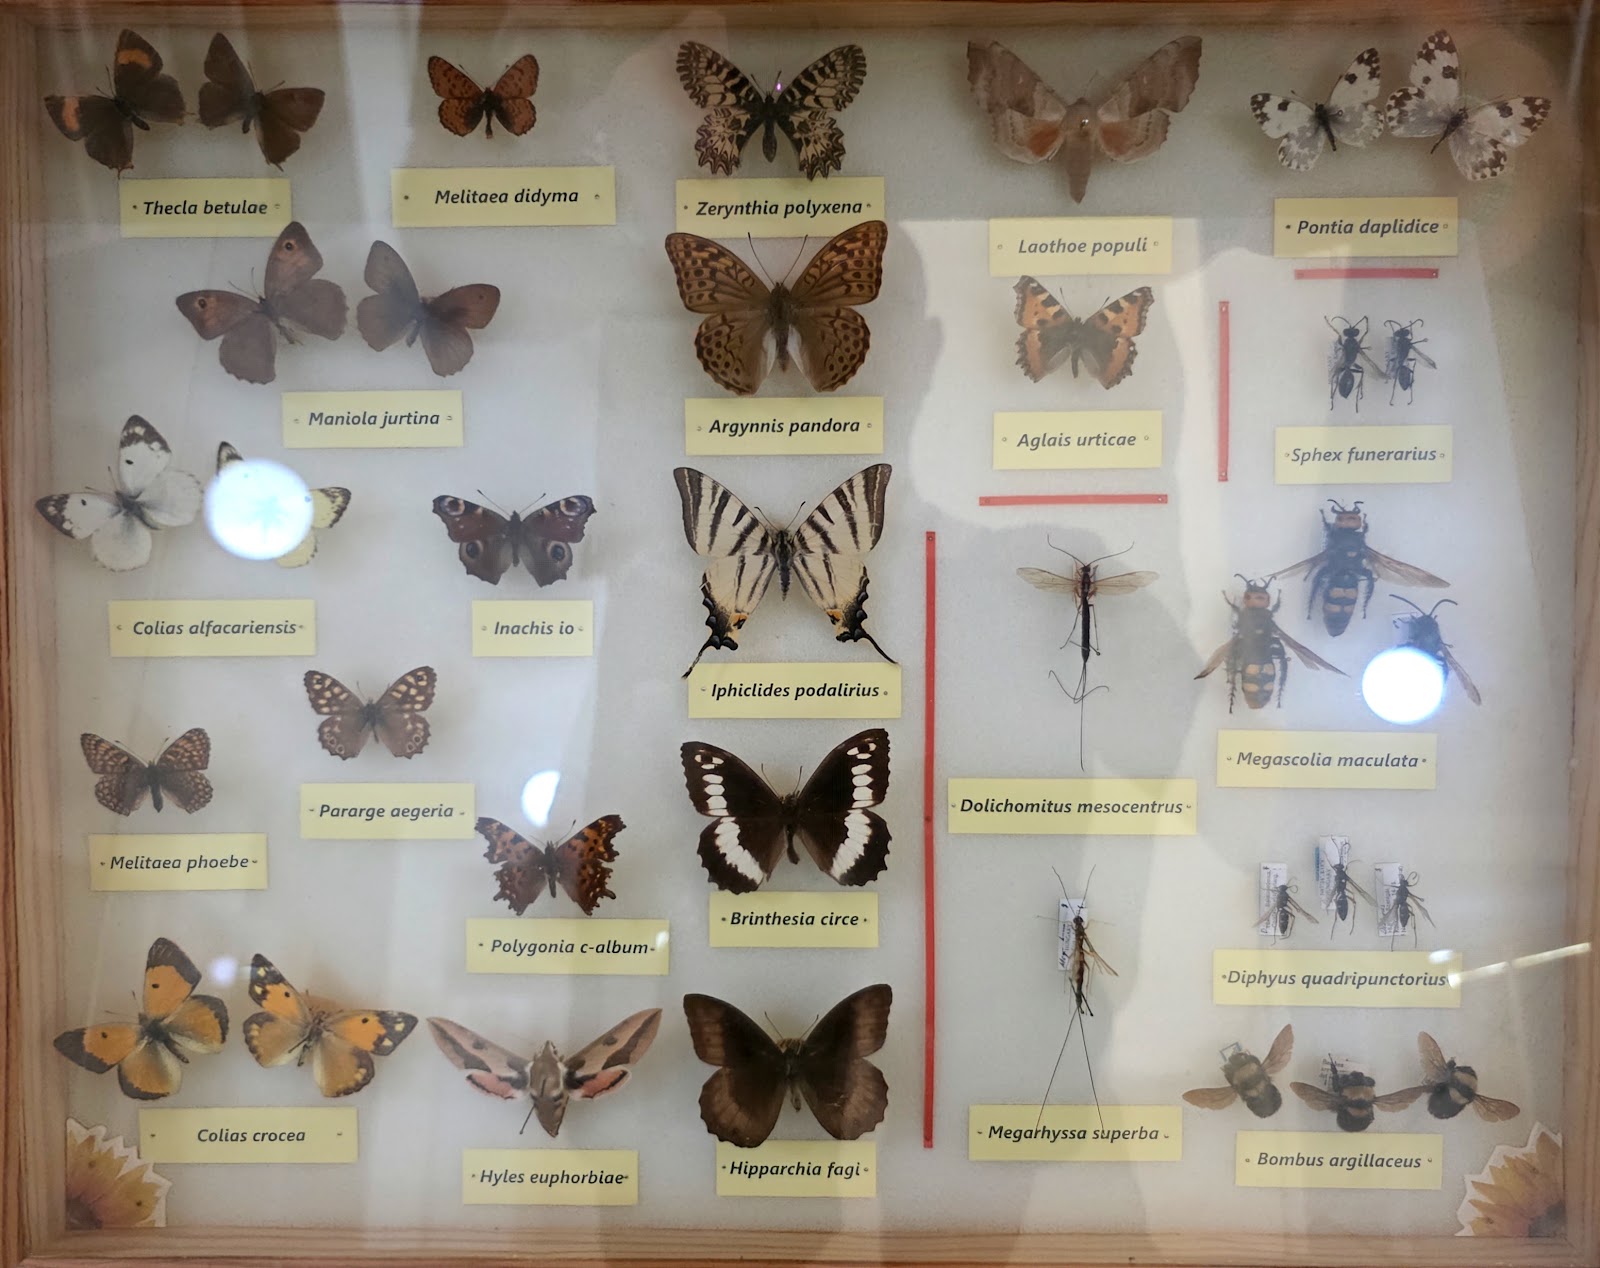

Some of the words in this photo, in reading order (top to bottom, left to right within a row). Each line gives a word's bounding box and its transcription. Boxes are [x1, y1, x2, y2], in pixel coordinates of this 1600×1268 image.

[143, 199, 198, 215] Thecla
[203, 199, 268, 215] betulae
[434, 189, 509, 205] Melitaea
[514, 188, 579, 207] didyma
[695, 199, 779, 220] Zerynthia
[783, 199, 862, 220] polyxena
[1297, 219, 1354, 235] Pontia
[1359, 218, 1440, 238] daplidice
[1018, 238, 1087, 254] Laothoe
[1090, 237, 1148, 257] populi
[308, 410, 378, 426] Maniola
[379, 410, 440, 429] jurtina
[708, 418, 784, 438] Argynnis
[788, 417, 860, 437] pandora
[1016, 432, 1072, 452] Aglais
[1076, 431, 1137, 447] urticae
[1291, 447, 1343, 466] Sphex
[1347, 446, 1438, 465] funerarius
[132, 620, 184, 636] Colias
[188, 620, 297, 638] alfacariensis
[494, 620, 554, 635] Inachis
[559, 620, 575, 635] io
[711, 682, 790, 701] Iphiclides
[794, 682, 880, 701] podalirius
[1236, 751, 1333, 770] Megascolia
[1337, 752, 1419, 768] maculata
[319, 804, 386, 822] Pararge
[390, 803, 454, 822] aegeria
[960, 798, 1072, 814] Dolichomitus
[1076, 800, 1183, 814] mesocentrus
[109, 855, 182, 870] Melitaea
[186, 854, 249, 873] phoebe
[730, 911, 815, 926] Brinthesia
[820, 911, 859, 926] circe
[491, 938, 575, 957] Polygonia
[579, 939, 649, 954] c-album
[1227, 969, 1296, 989] Diphyus
[1301, 971, 1447, 990] quadripunctorius
[197, 1128, 248, 1143] Colias
[252, 1131, 306, 1142] crocea
[988, 1125, 1087, 1144] Megarhyssa
[1092, 1125, 1159, 1144] superba
[730, 1160, 822, 1179] Hipparchia
[827, 1161, 860, 1180] fagi
[1257, 1152, 1324, 1167] Bombus
[1329, 1153, 1422, 1171] argillaceus
[480, 1169, 525, 1187] Hyles
[530, 1169, 624, 1188] euphorbiae
